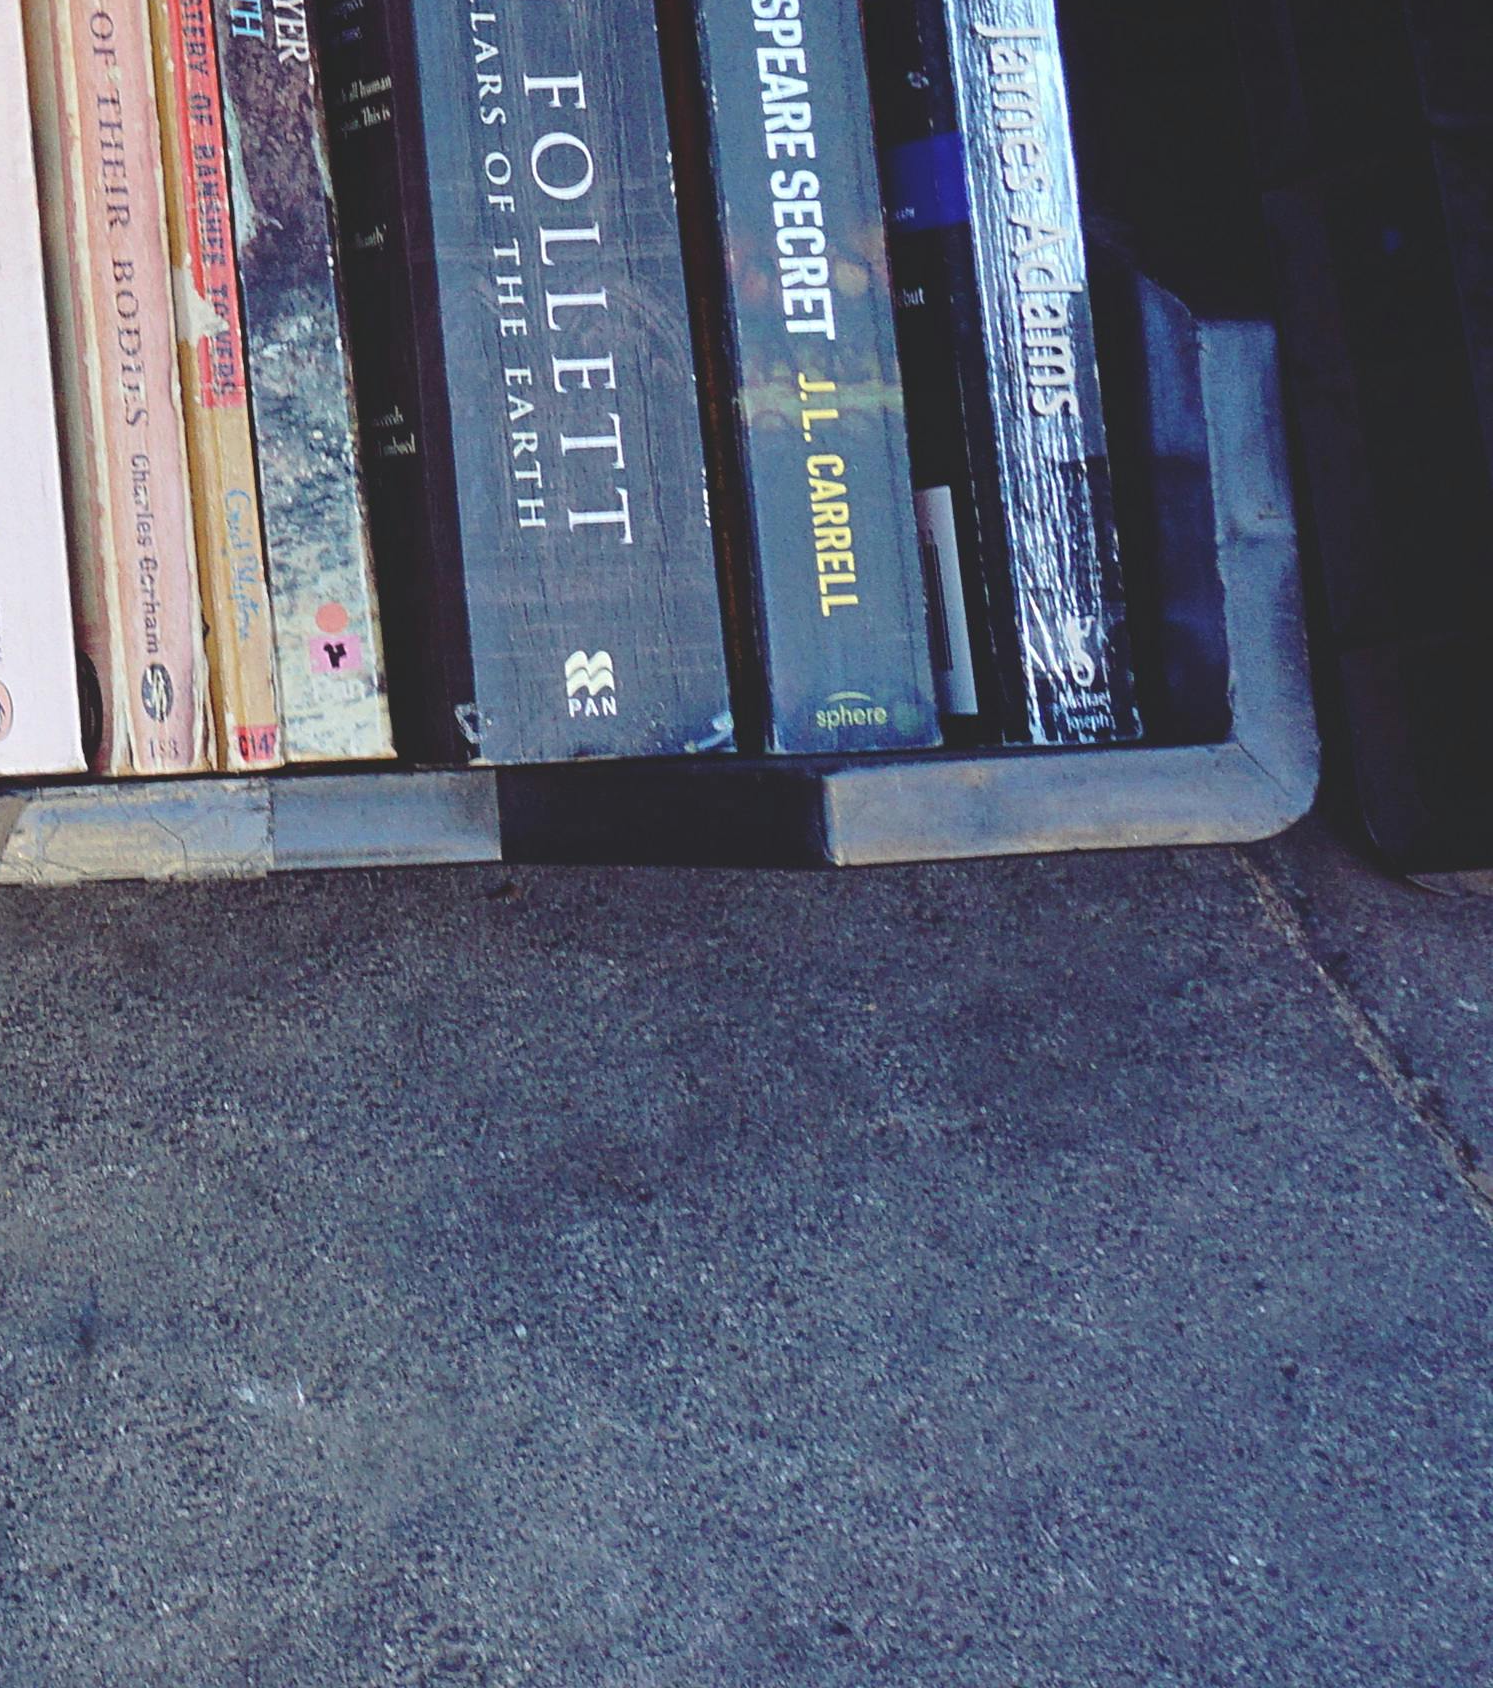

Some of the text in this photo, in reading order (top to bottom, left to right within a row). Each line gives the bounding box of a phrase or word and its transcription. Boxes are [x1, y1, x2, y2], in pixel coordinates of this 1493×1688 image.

[89, 13, 117, 79] OF
[96, 87, 131, 229] THEIR
[191, 93, 213, 127] OF
[194, 144, 227, 267] BANSHEE
[484, 151, 515, 212] OF
[974, 22, 1084, 420] James Adams
[492, 239, 528, 336] THE
[524, 69, 634, 546] FOLLETT
[770, 169, 836, 341] SECRET
[112, 257, 149, 428] BODIES
[130, 453, 155, 548] Charles
[503, 364, 548, 530] EARTH
[799, 372, 859, 618] J. L. CARRELL
[569, 697, 617, 717] PAN
[815, 704, 887, 730] sphere
